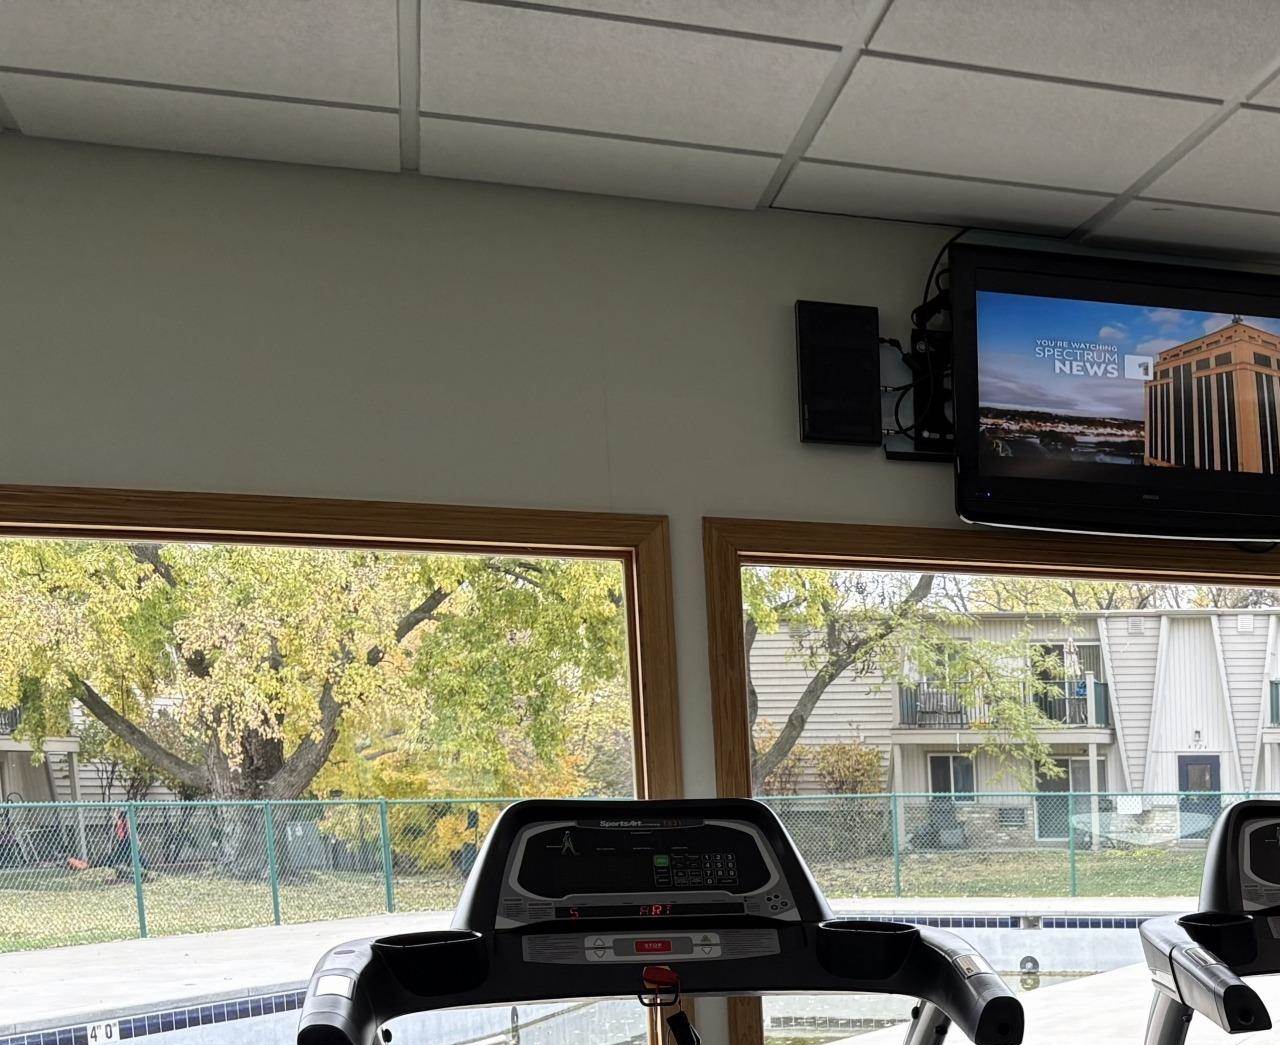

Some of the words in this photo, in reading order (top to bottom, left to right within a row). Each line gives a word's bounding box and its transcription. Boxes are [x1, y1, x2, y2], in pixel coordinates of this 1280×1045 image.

[1036, 339, 1068, 348] YOU'RE
[1071, 342, 1118, 352] WATCHING
[1035, 347, 1118, 364] SPECTRUM
[1055, 359, 1118, 378] NEWS
[1138, 361, 1149, 377] 1
[600, 819, 642, 828] SportsArt
